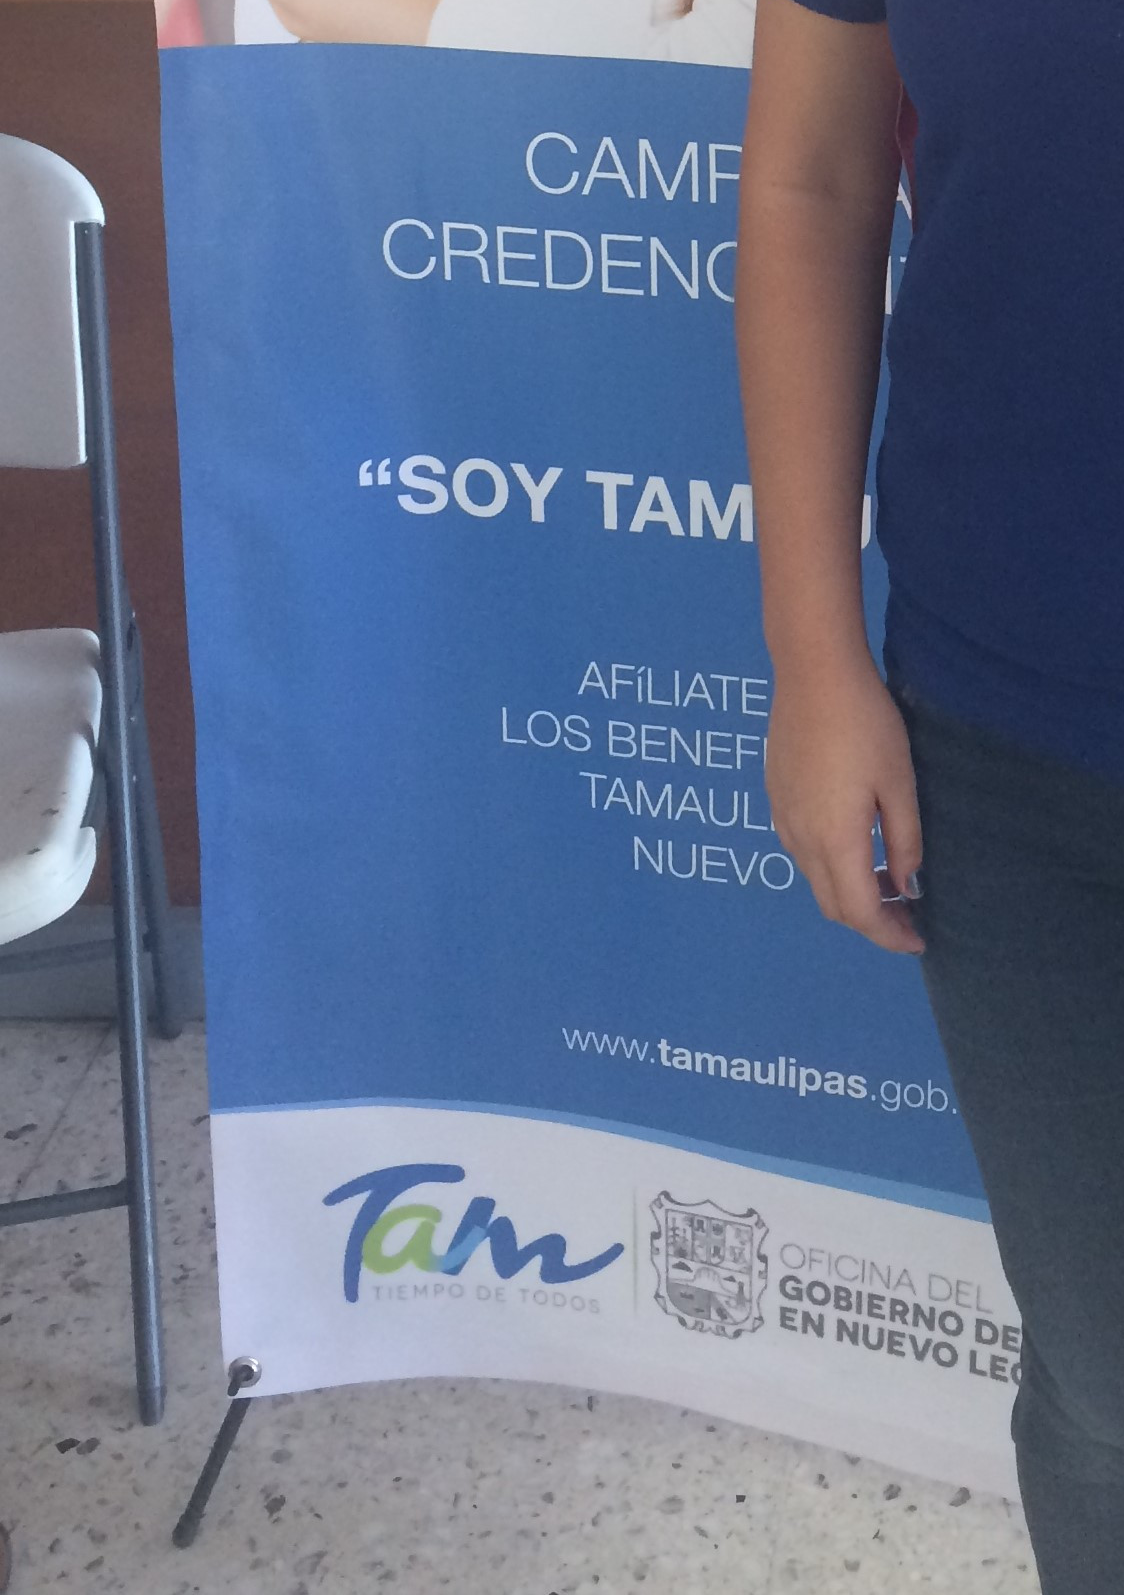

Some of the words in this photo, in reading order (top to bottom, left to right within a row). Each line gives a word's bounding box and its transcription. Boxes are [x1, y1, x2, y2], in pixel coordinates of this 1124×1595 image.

[525, 131, 743, 205] CAMP
[381, 217, 738, 304] CREDENC
[585, 470, 755, 543] TAM
[501, 707, 592, 752] LOS
[607, 719, 768, 771] BENEFI
[579, 770, 776, 833] TAMAUL
[633, 835, 795, 891] NUEVO
[322, 1162, 625, 1304] Tam
[371, 1283, 466, 1302] TIEMPO
[475, 1284, 507, 1303] DE
[517, 1287, 602, 1315] TODOS
[778, 1274, 964, 1338] GOBIERNO
[779, 1242, 917, 1297] OFICINA
[927, 1273, 994, 1315] DEL
[779, 1306, 825, 1339] EN
[835, 1317, 959, 1369] NUEVO
